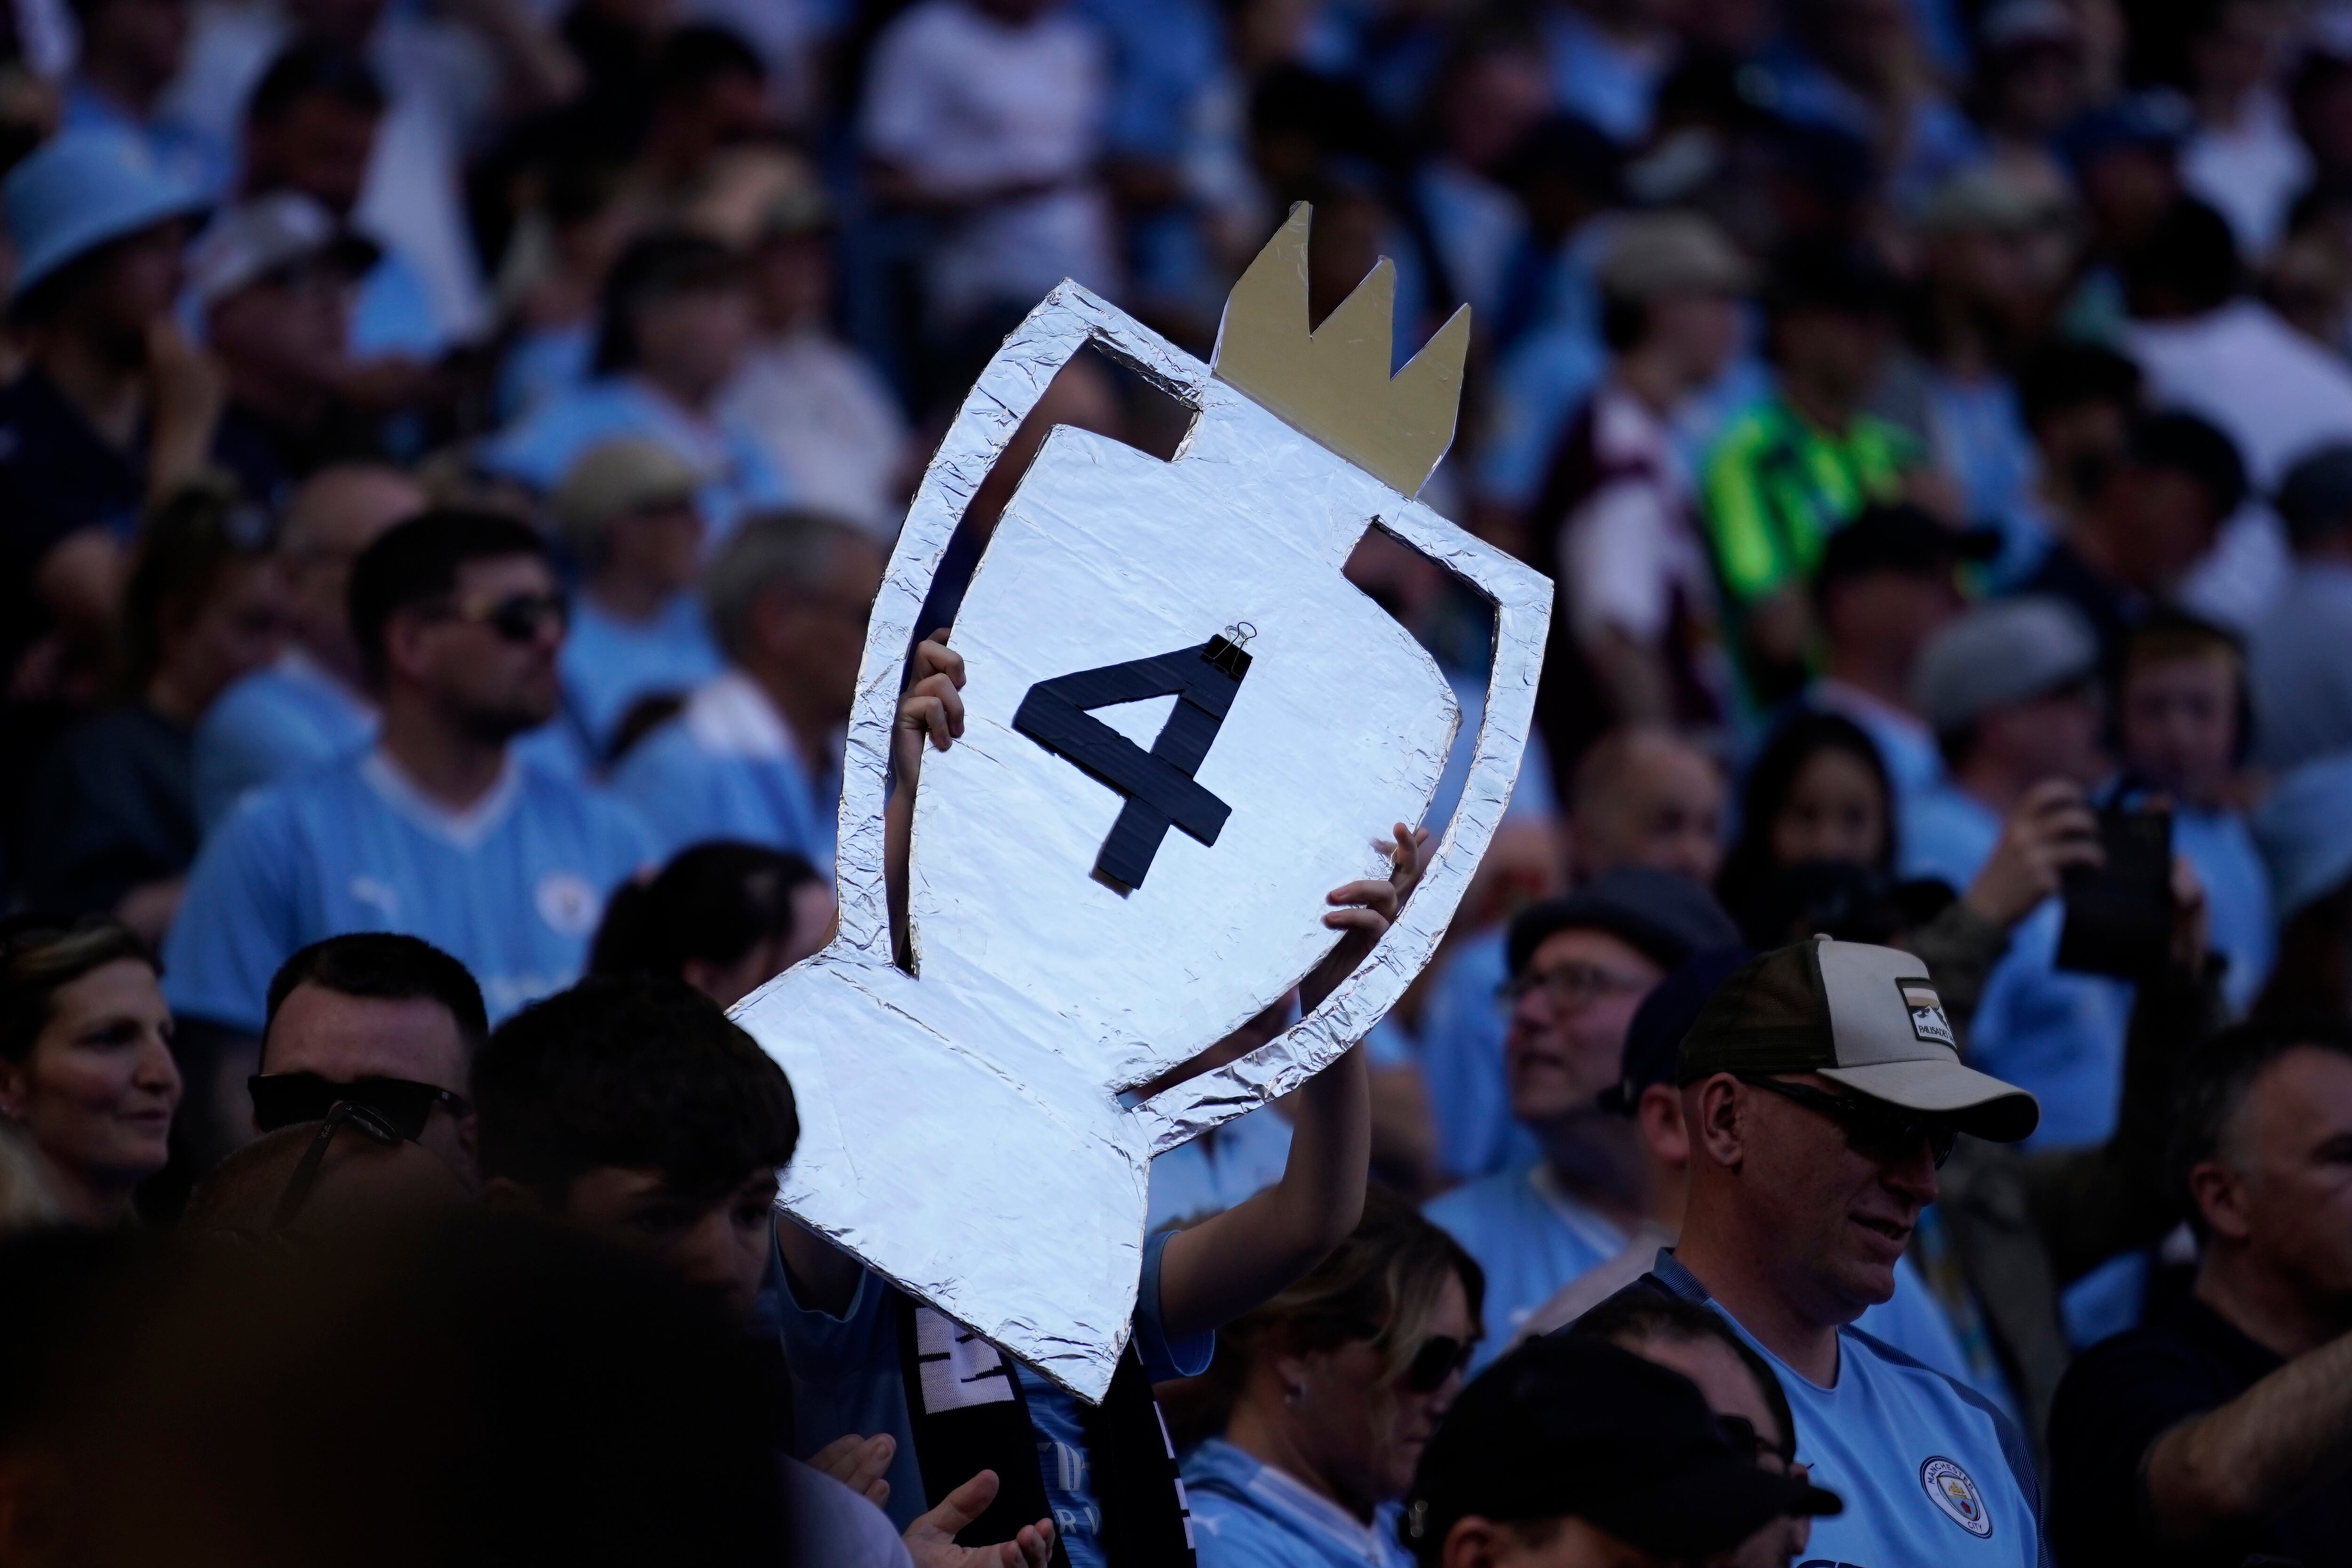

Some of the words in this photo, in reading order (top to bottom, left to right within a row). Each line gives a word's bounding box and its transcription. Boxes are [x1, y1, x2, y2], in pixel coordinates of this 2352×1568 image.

[1011, 637, 1252, 897] 4
[1928, 1463, 1973, 1490] MANCHESTER
[1968, 1521, 1982, 1531] CITY
